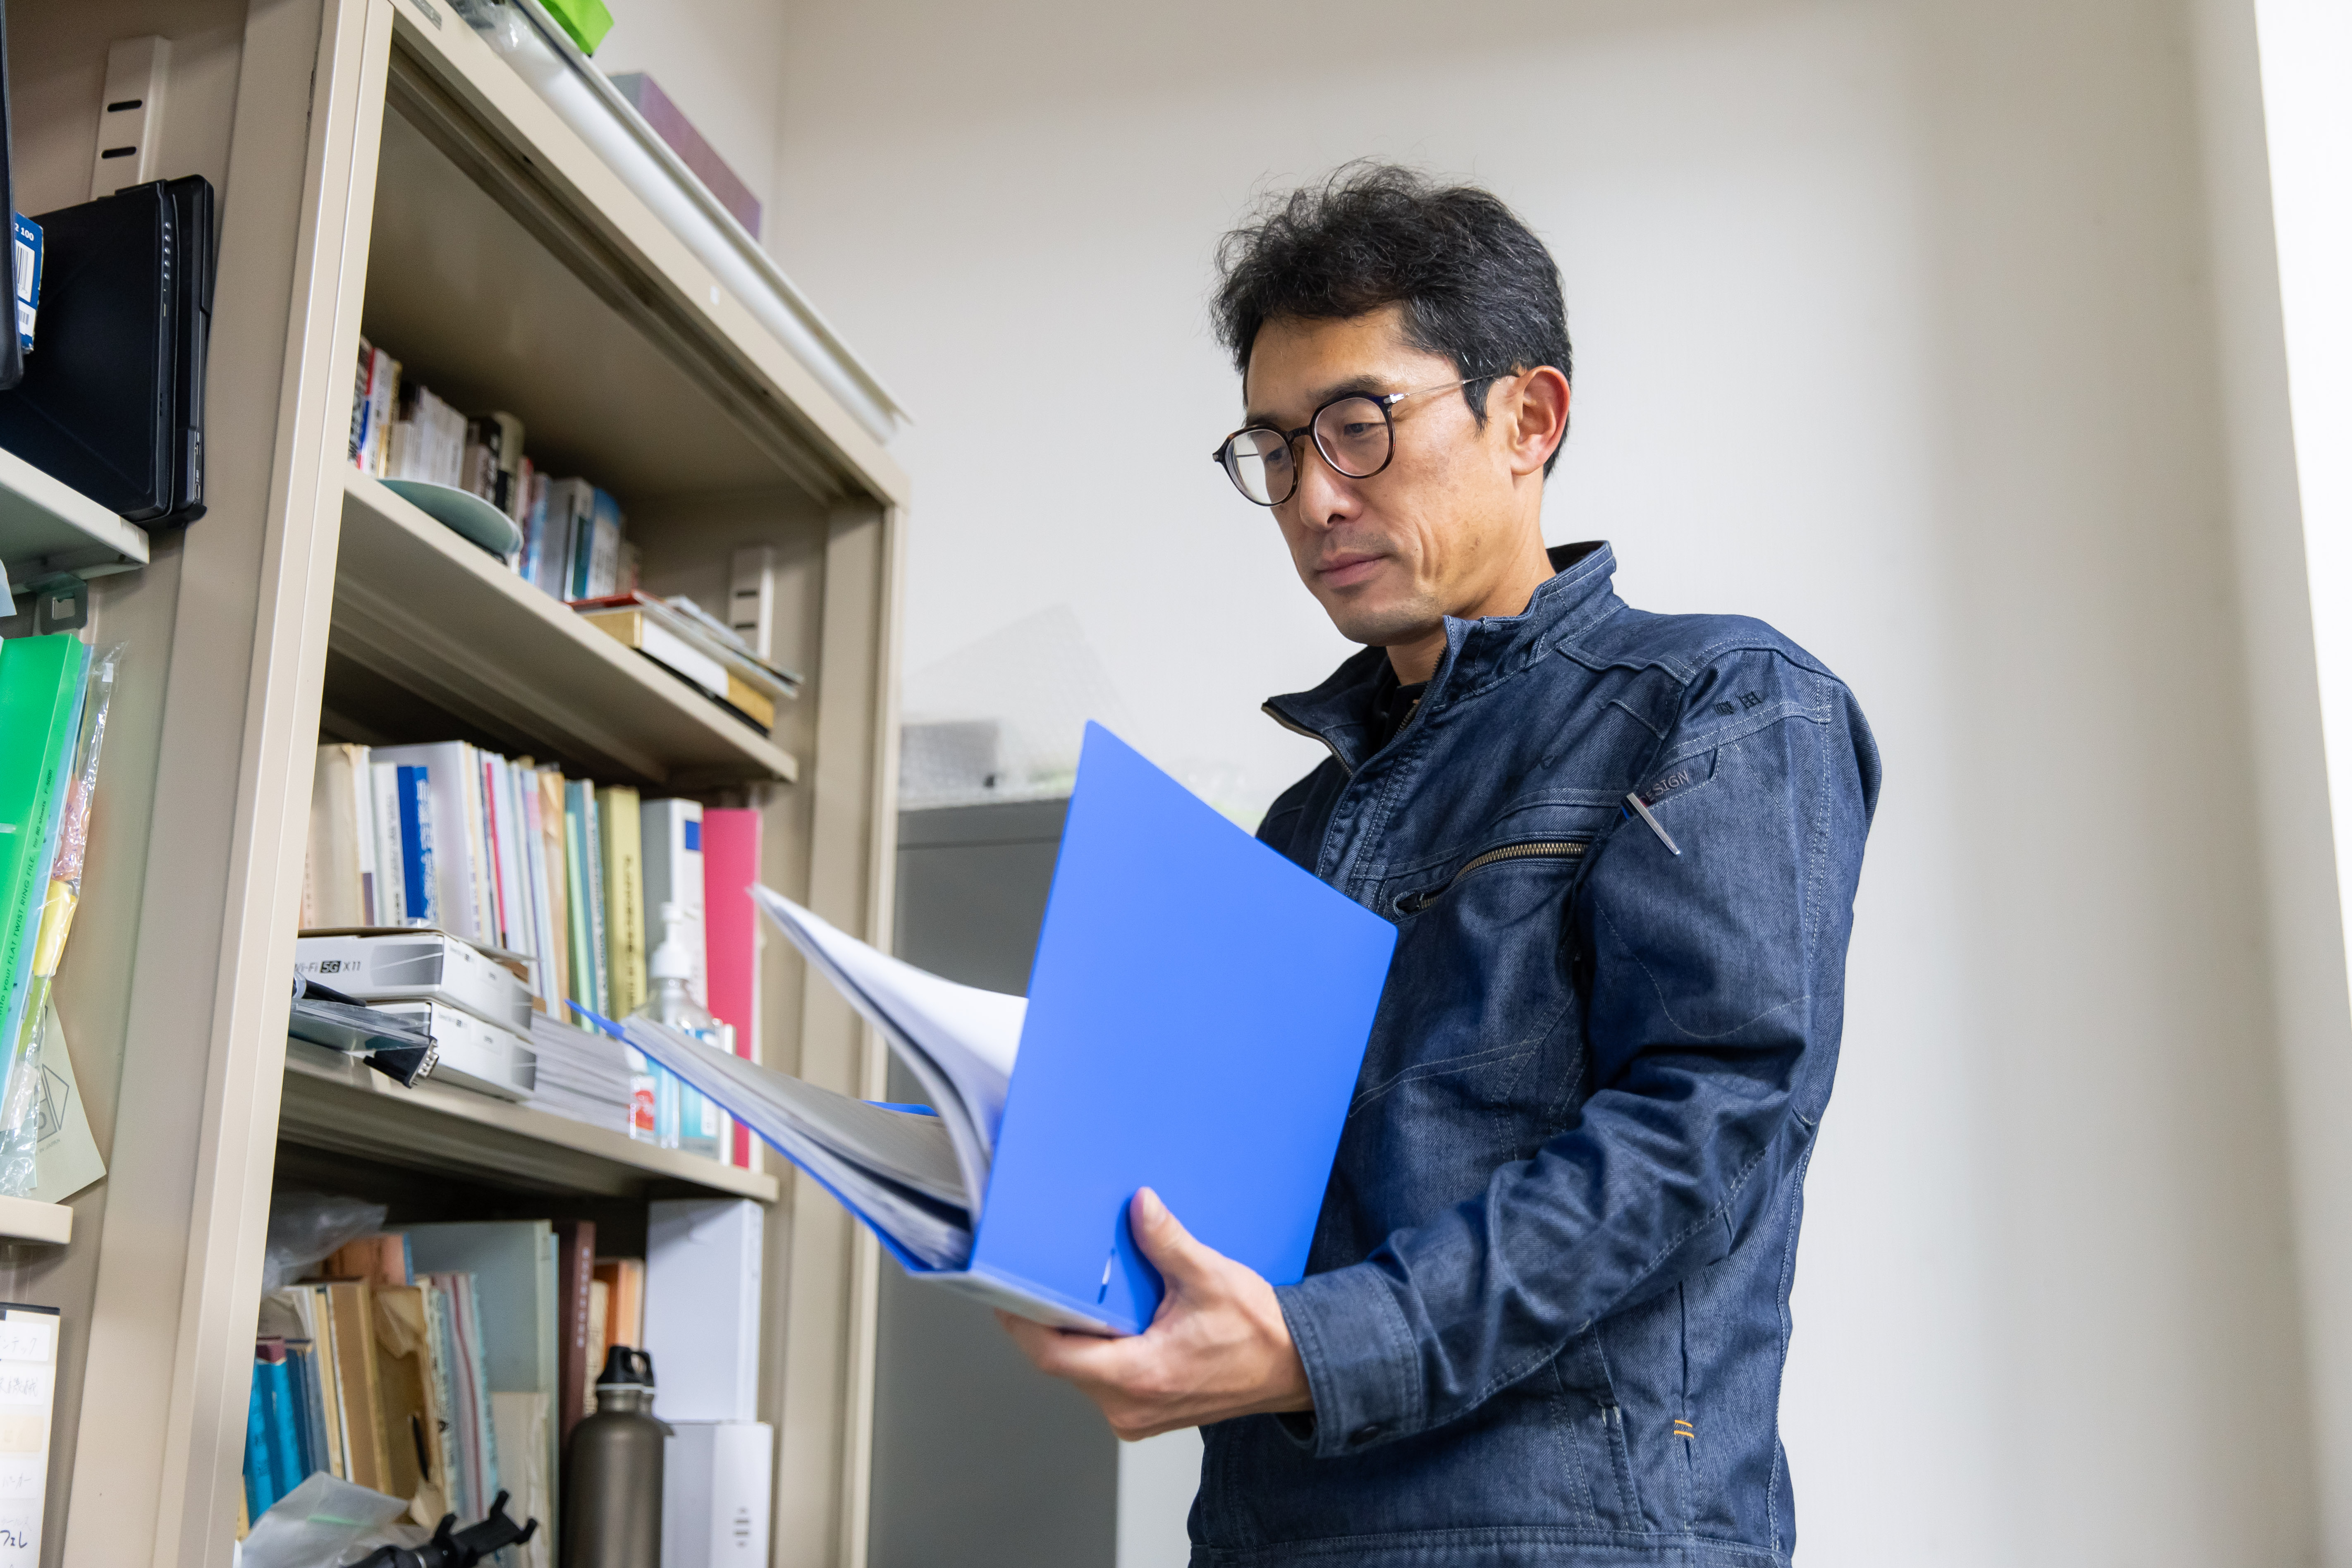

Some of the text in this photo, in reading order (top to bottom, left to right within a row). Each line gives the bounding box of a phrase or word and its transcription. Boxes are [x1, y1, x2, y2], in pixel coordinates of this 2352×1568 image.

[21, 227, 34, 241] 100
[7, 941, 17, 965] FLAT
[13, 909, 24, 937] TWIST
[20, 880, 30, 906] RING
[320, 961, 340, 973] 5G
